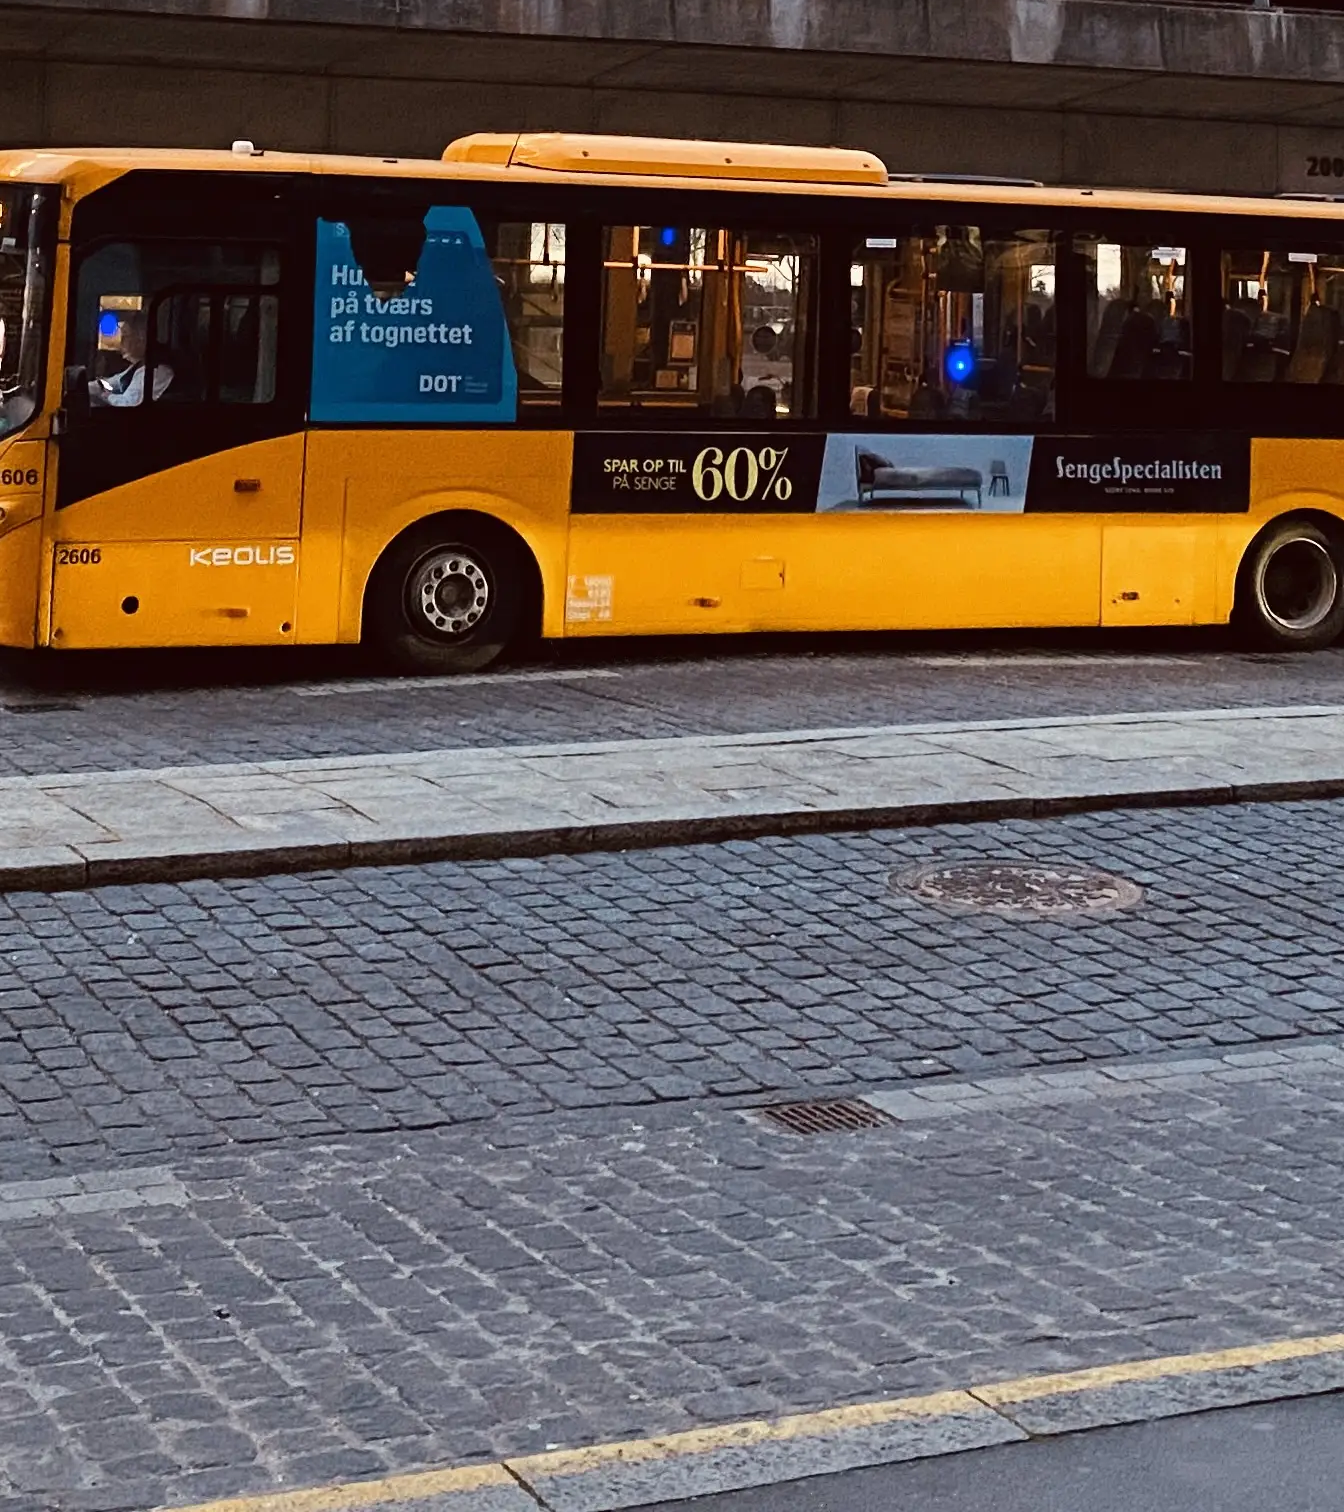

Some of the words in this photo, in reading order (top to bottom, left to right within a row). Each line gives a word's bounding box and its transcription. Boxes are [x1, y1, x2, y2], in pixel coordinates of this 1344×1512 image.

[330, 290, 359, 318] på
[364, 293, 433, 315] tværs
[329, 320, 355, 342] af
[360, 324, 473, 347] tognettet
[419, 374, 462, 392] DOT
[603, 459, 639, 473] SPAR
[642, 459, 664, 473] OP
[667, 459, 687, 473] TIL
[692, 446, 793, 501] 60%
[1056, 456, 1223, 484] SengeSpecialisten
[612, 473, 631, 490] PÅ
[634, 476, 677, 490] SENGE
[58, 548, 102, 565] 2606
